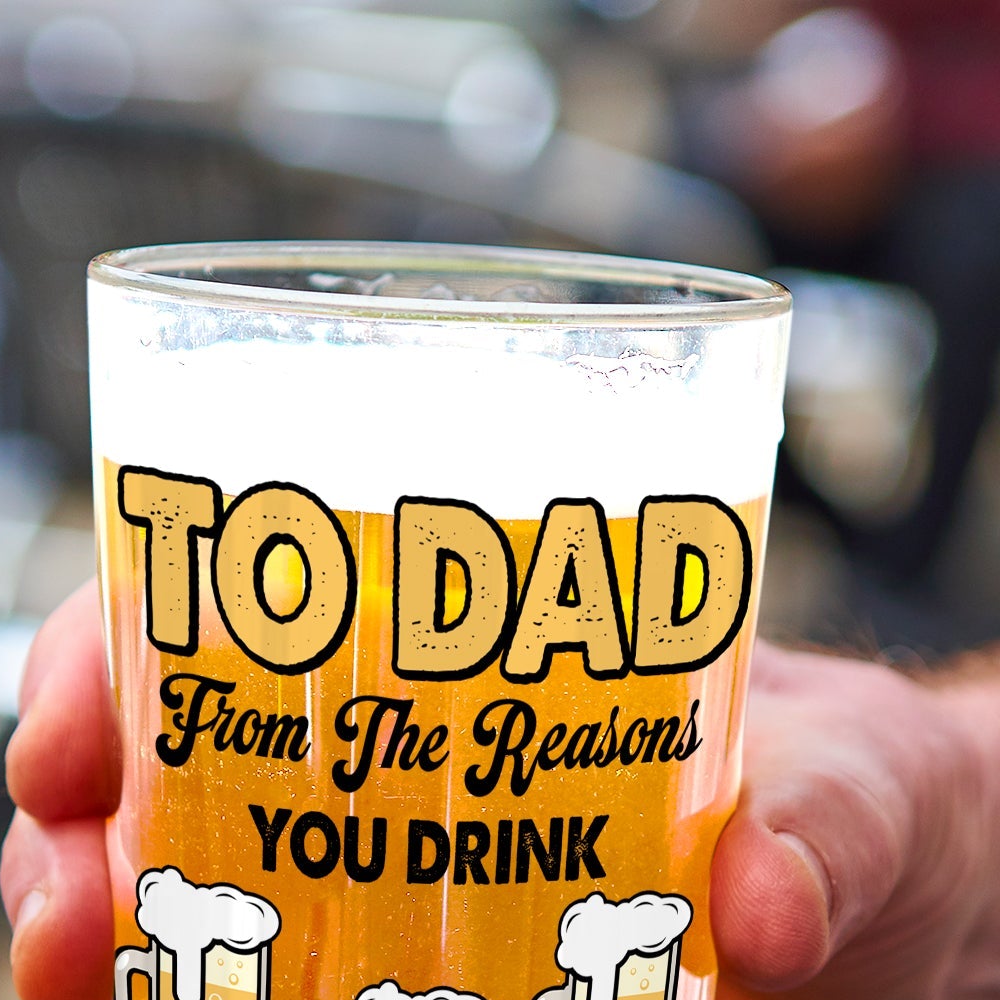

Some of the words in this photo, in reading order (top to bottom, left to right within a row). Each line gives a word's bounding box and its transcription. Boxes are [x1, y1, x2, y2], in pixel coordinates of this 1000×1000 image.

[117, 465, 358, 676] TO
[392, 495, 753, 684] DAD
[155, 673, 314, 768] From
[331, 695, 450, 793] The
[464, 698, 704, 797] Reasons
[248, 804, 388, 883] YOU
[406, 814, 610, 886] DRINK
